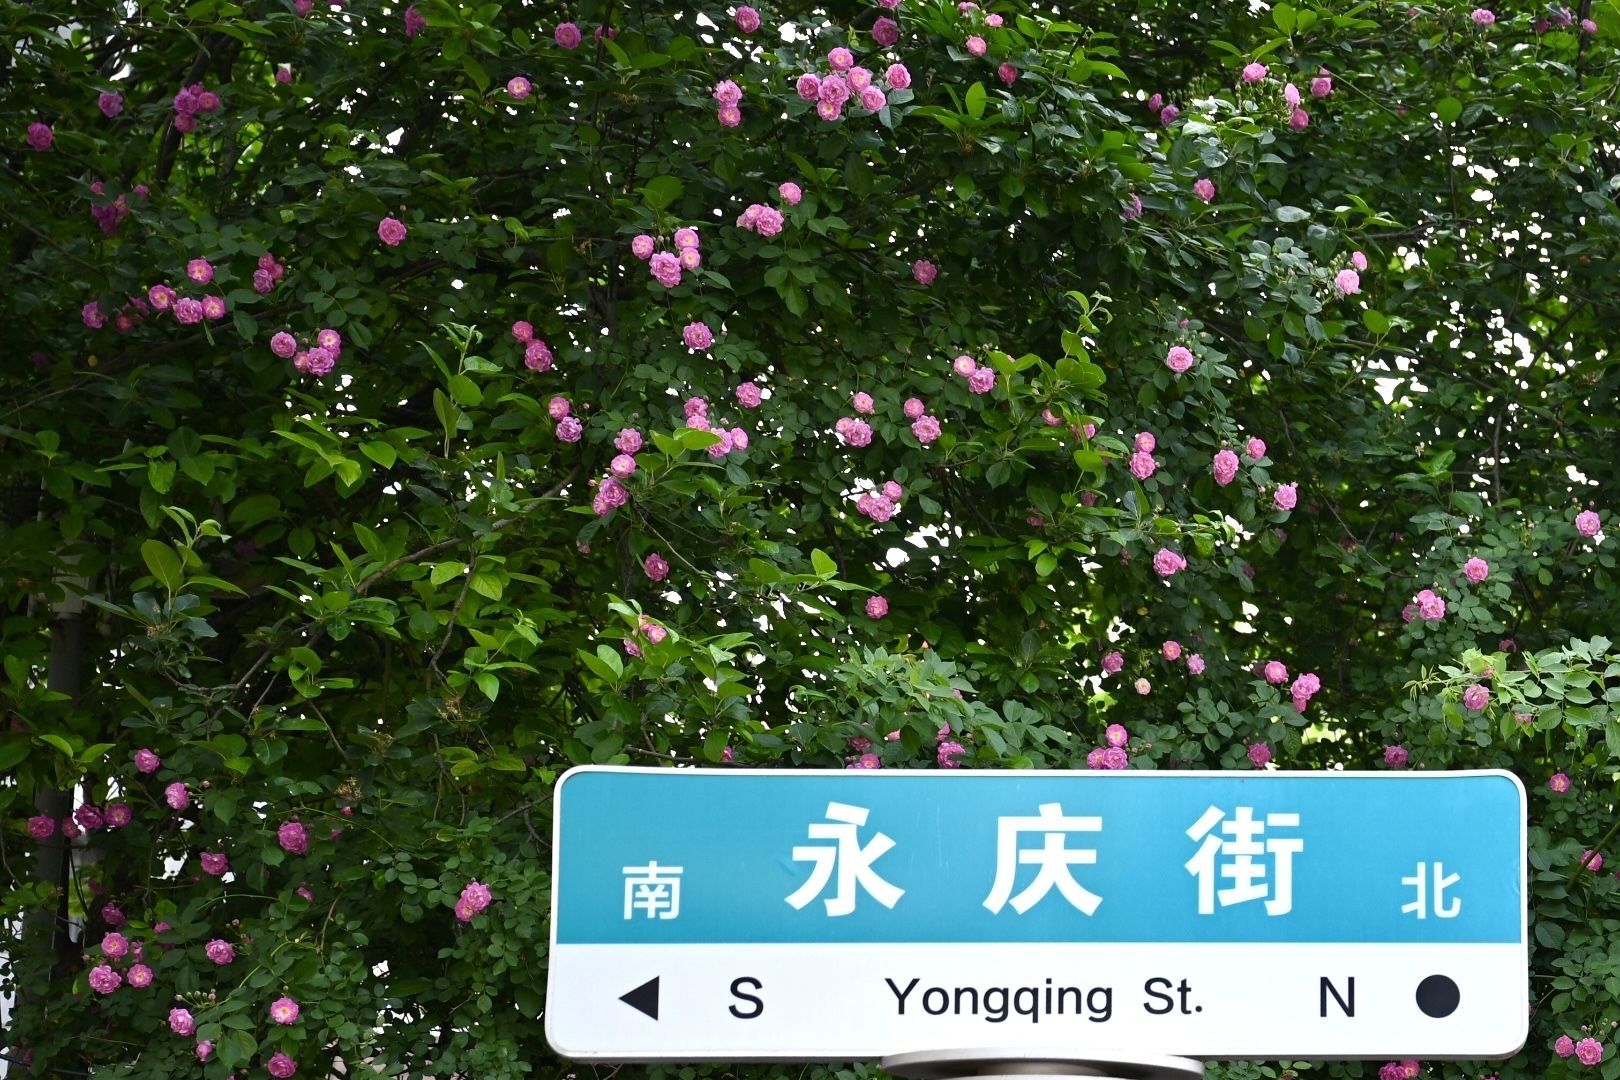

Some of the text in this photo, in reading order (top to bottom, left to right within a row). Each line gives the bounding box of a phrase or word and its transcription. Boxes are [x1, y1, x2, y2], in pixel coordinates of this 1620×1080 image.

[623, 801, 1462, 920] 南 永庆街 北
[728, 976, 1355, 1024] S Yongqing St. N
